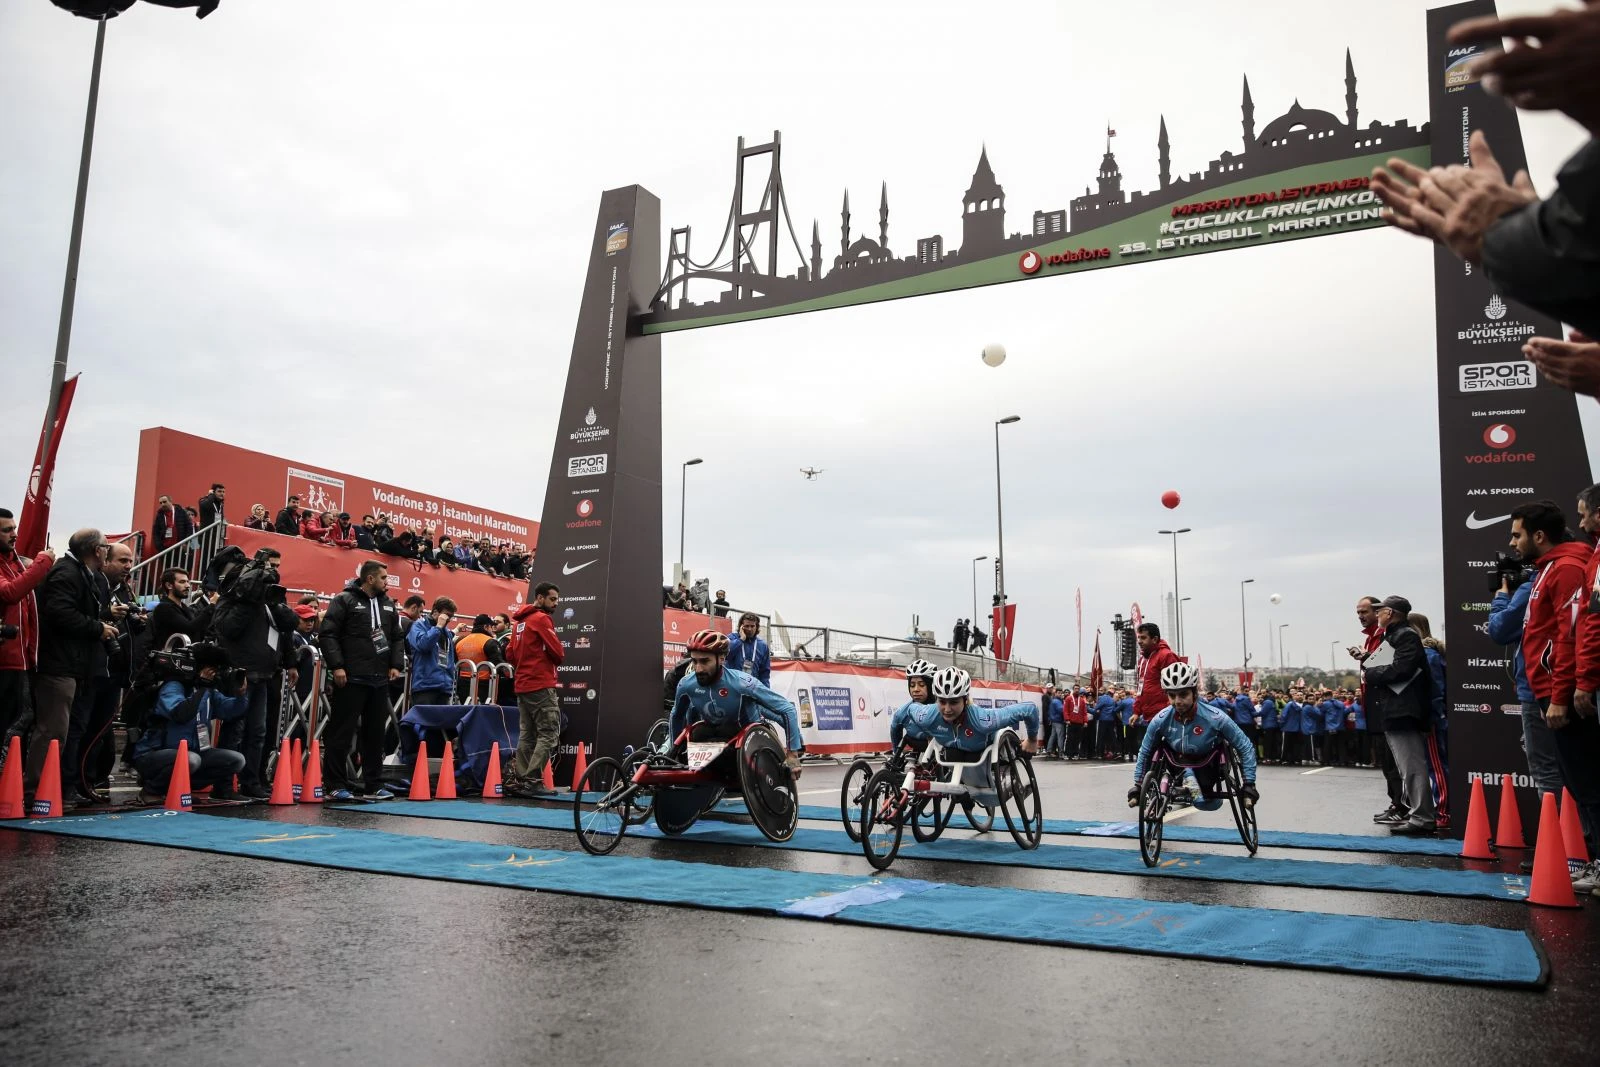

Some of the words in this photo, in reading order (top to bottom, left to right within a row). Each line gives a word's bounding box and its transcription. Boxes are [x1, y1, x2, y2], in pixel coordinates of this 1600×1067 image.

[1448, 46, 1477, 57] IAAF
[1448, 75, 1470, 84] GOLD
[1045, 248, 1110, 264] vodafone
[1119, 241, 1152, 255] 39.
[1472, 320, 1520, 328] İSTANBUL
[1458, 324, 1535, 339] BÜYÜKŞEHİR
[1464, 364, 1530, 380] SPOR
[570, 456, 604, 468] SPOR
[1465, 451, 1536, 464] vodafone
[1490, 487, 1535, 495] SPONSOR
[372, 487, 424, 511] Vodafone
[425, 501, 441, 516] 39.
[442, 501, 483, 526] İstanbul
[484, 514, 528, 536] Maratonu
[565, 519, 602, 528] vodafone
[1467, 657, 1511, 668] HİZMET
